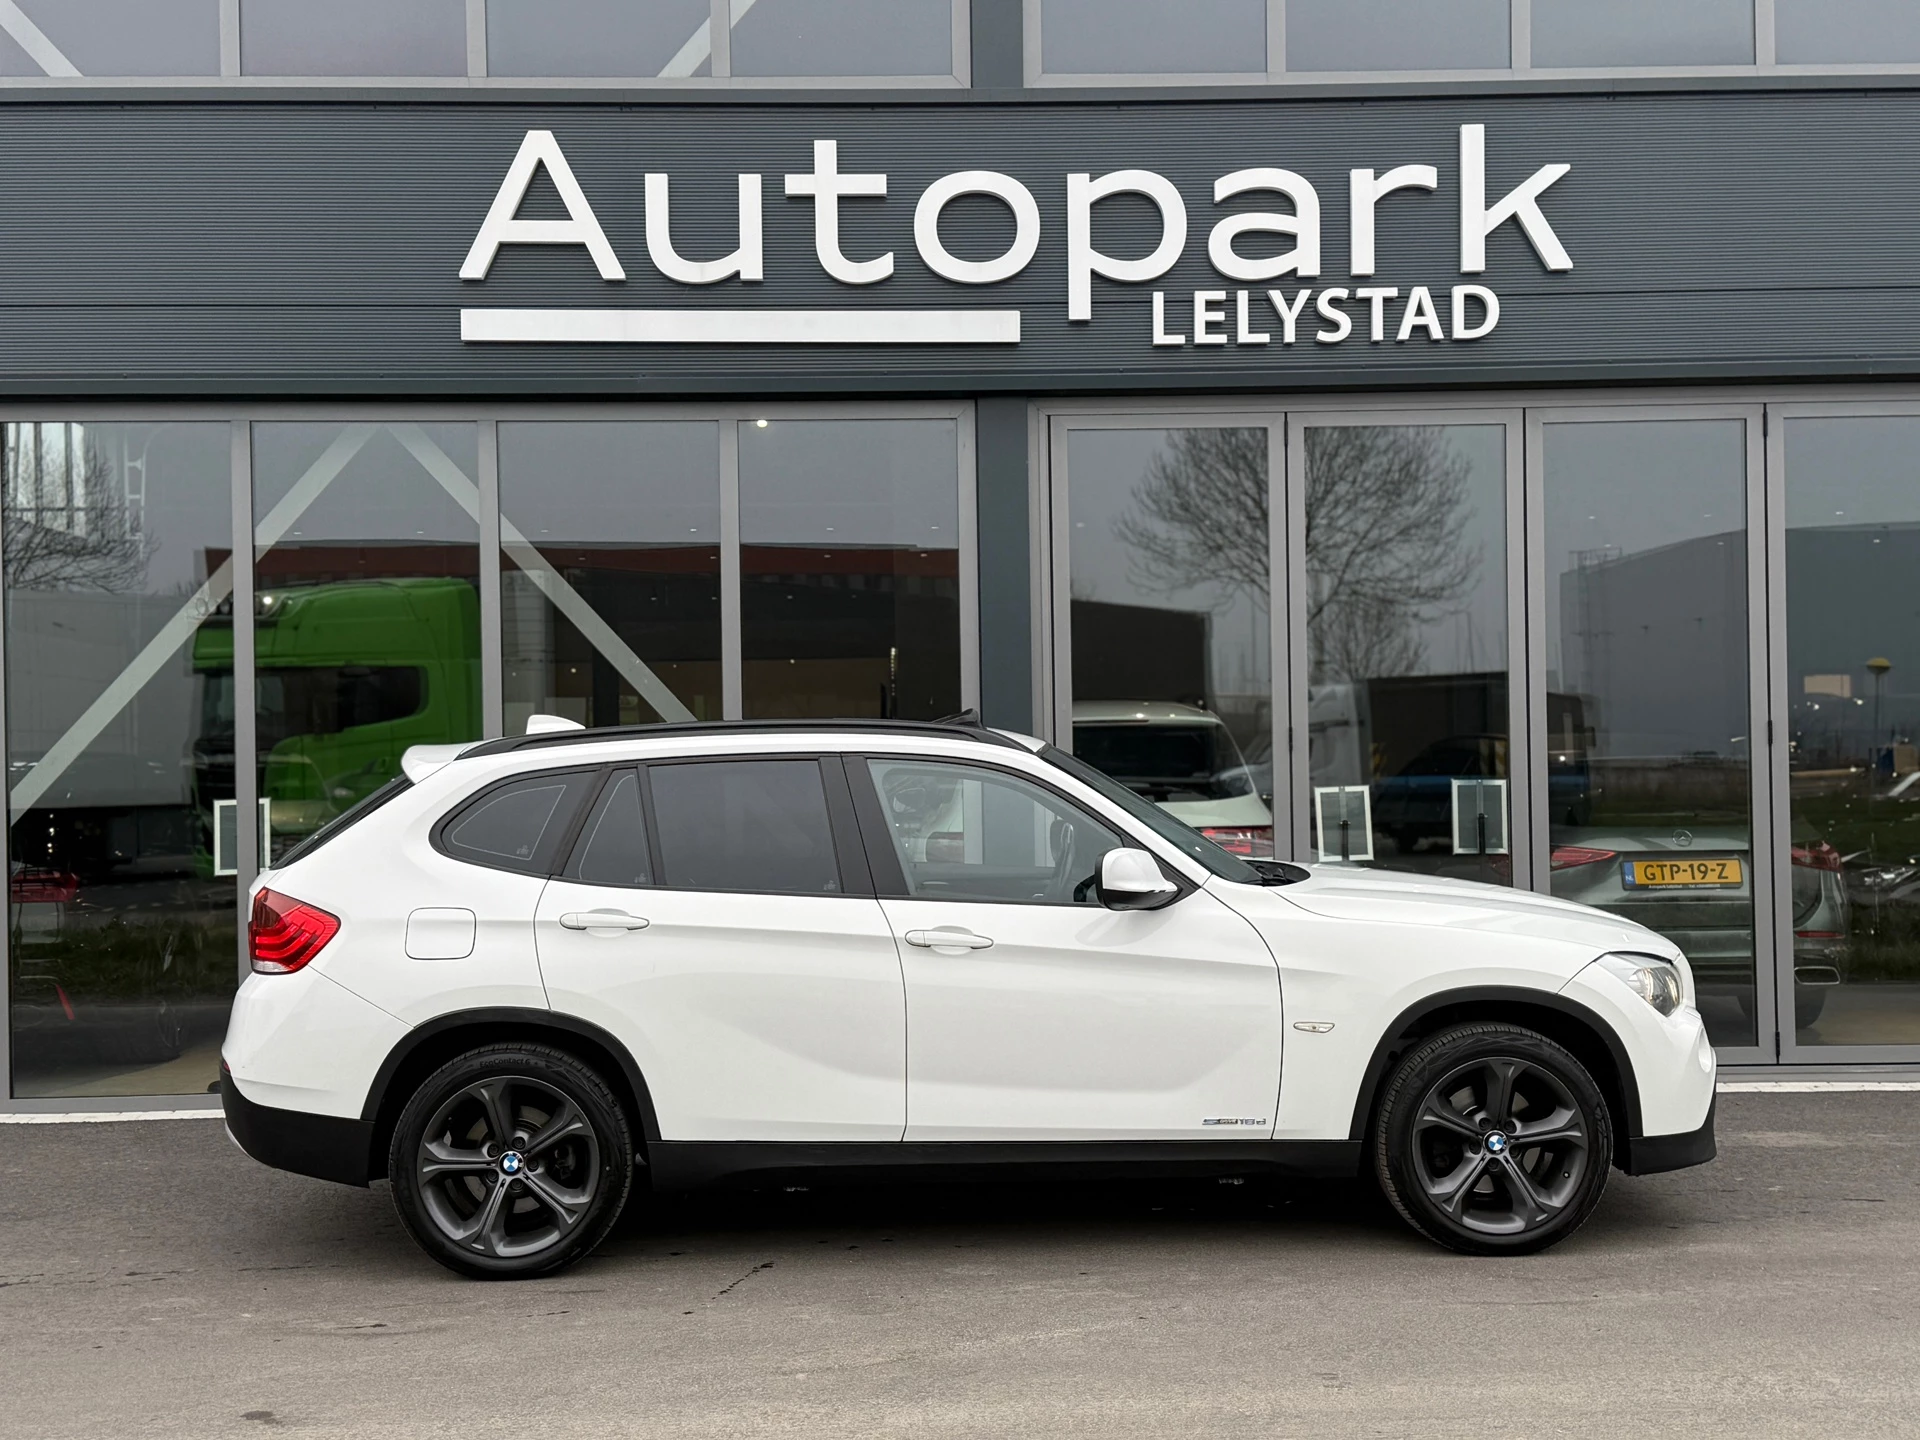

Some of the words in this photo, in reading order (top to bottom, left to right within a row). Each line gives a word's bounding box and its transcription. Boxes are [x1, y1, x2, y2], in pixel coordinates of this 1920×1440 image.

[458, 124, 1574, 322] Autopark
[1152, 285, 1500, 347] LELYSTAD
[1643, 864, 1728, 881] GTP-19-Z
